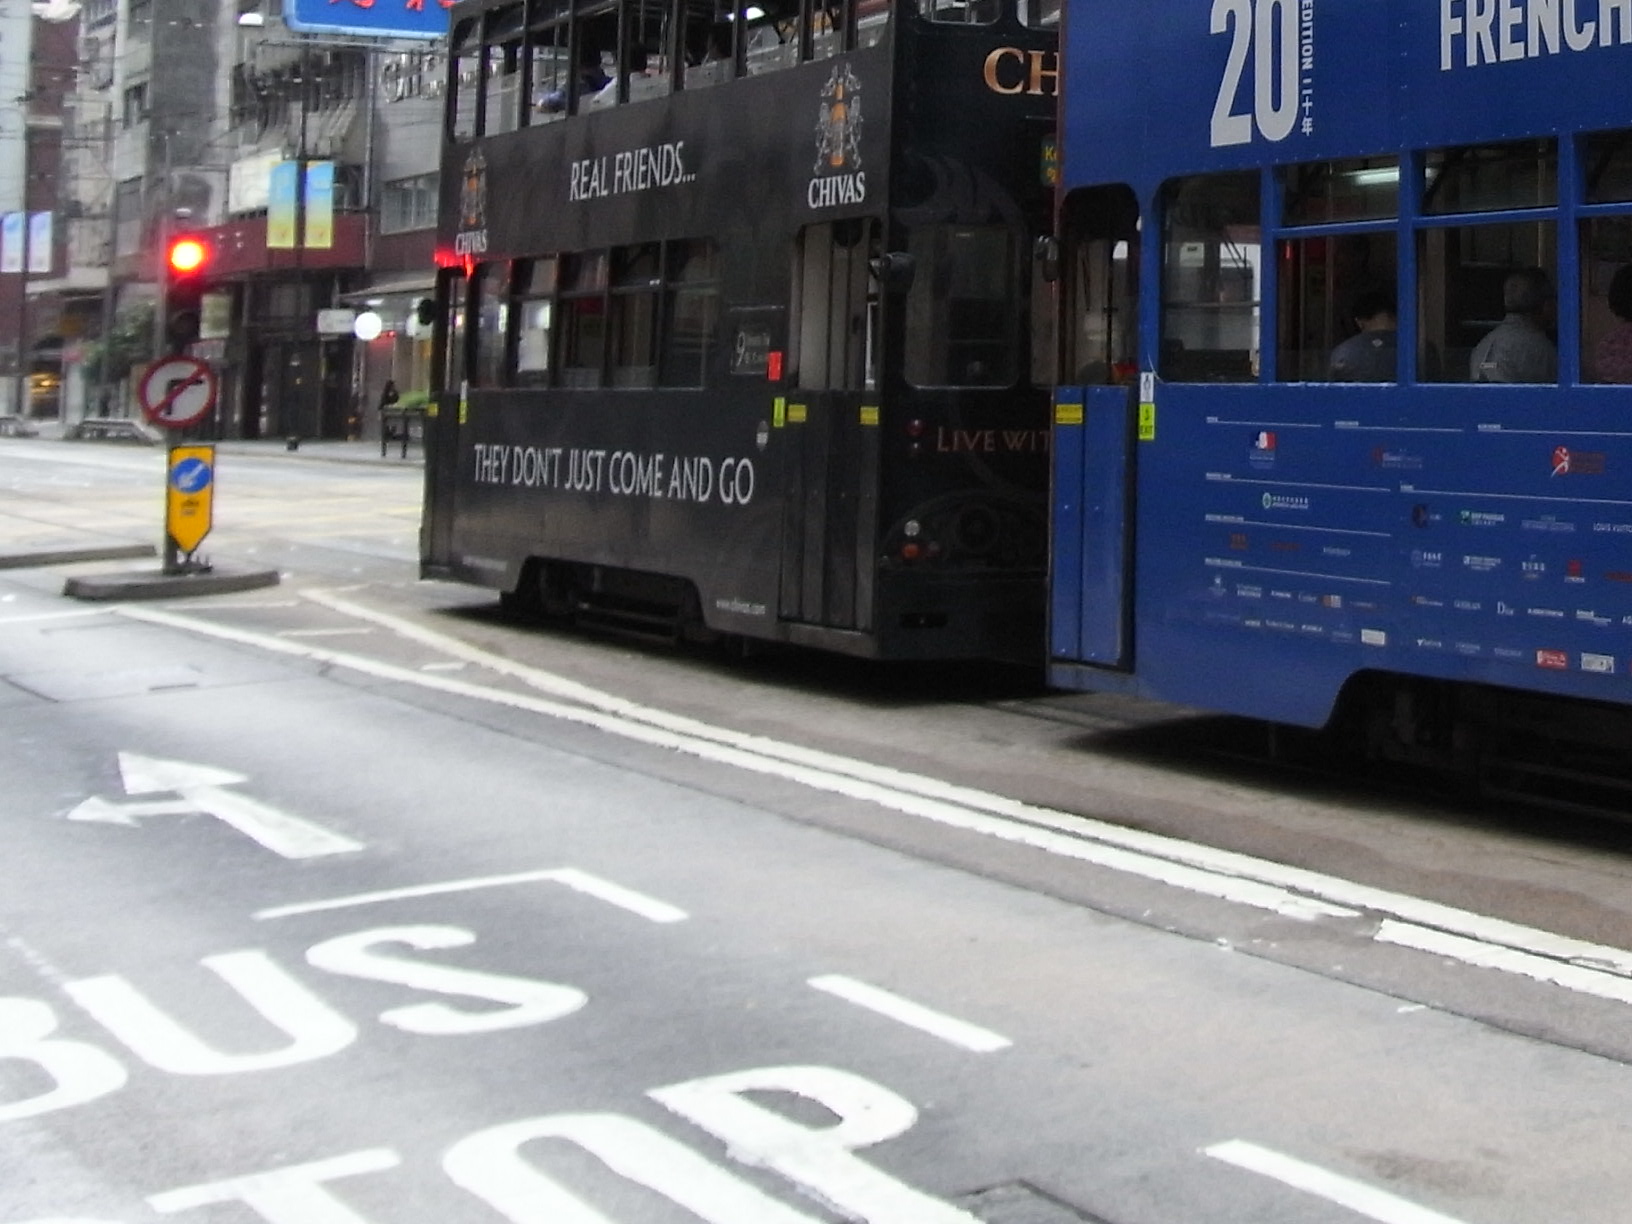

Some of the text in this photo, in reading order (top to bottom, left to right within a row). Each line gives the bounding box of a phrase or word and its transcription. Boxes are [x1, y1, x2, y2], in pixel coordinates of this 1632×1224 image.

[569, 139, 698, 203] REAL FRIENDS...
[807, 170, 867, 211] CHIVAS
[454, 229, 489, 256] CHIVAS
[937, 425, 996, 453] LIVE
[474, 443, 755, 506] THEY DON'T JUST COME AND GO
